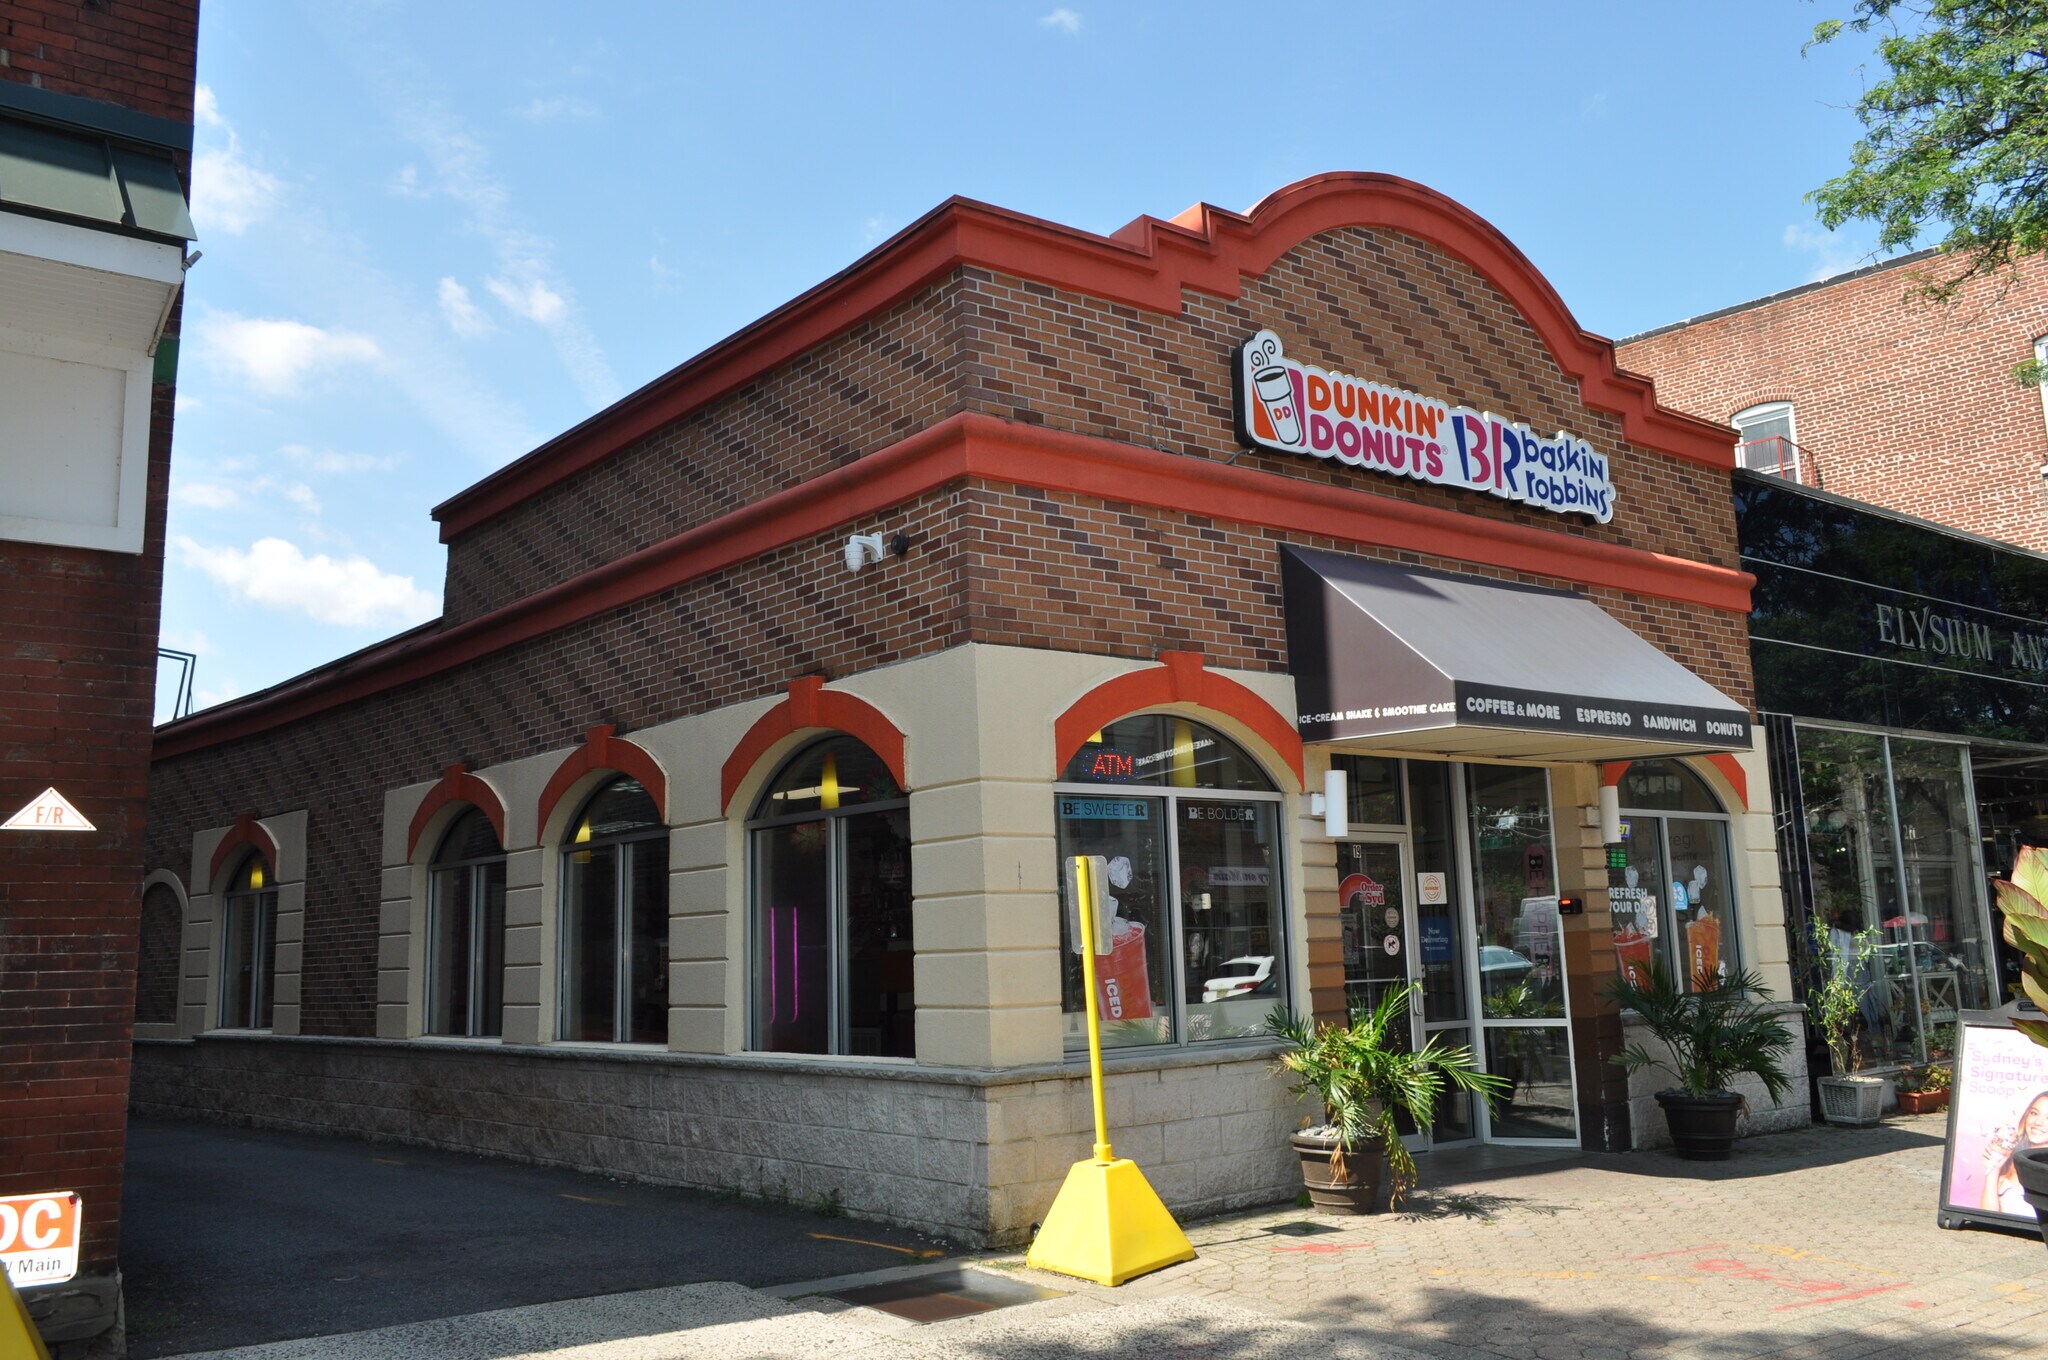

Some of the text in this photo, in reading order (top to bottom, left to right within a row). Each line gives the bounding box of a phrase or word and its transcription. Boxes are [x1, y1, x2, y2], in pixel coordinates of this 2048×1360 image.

[1274, 404, 1291, 420] DD
[1307, 374, 1444, 439] DUNKIN'
[1310, 419, 1443, 477] DONUTS
[1876, 603, 1993, 661] ELYSIUM
[1299, 711, 1345, 724] ICE-CREAM
[1346, 708, 1373, 720] SHAKE
[1382, 704, 1428, 717] SMOOTHIE
[1429, 701, 1456, 713] CAKE
[1466, 697, 1744, 737] COFFEE & MORE ESPRESSO SANDWICH DONUTS
[1092, 754, 1134, 777] ATM
[36, 806, 64, 824] F/R
[1063, 802, 1146, 817] BE SWEETER
[1188, 806, 1256, 821] BE BOLDER
[1353, 845, 1362, 858] 19
[1361, 882, 1383, 892] Order
[1608, 887, 1648, 899] REFRESH
[1365, 893, 1384, 906] Syd
[1104, 978, 1123, 1018] ICED
[1972, 1049, 2043, 1068] Sydney's
[1970, 1081, 2016, 1099] Scoop
[18, 1256, 61, 1274] Main
